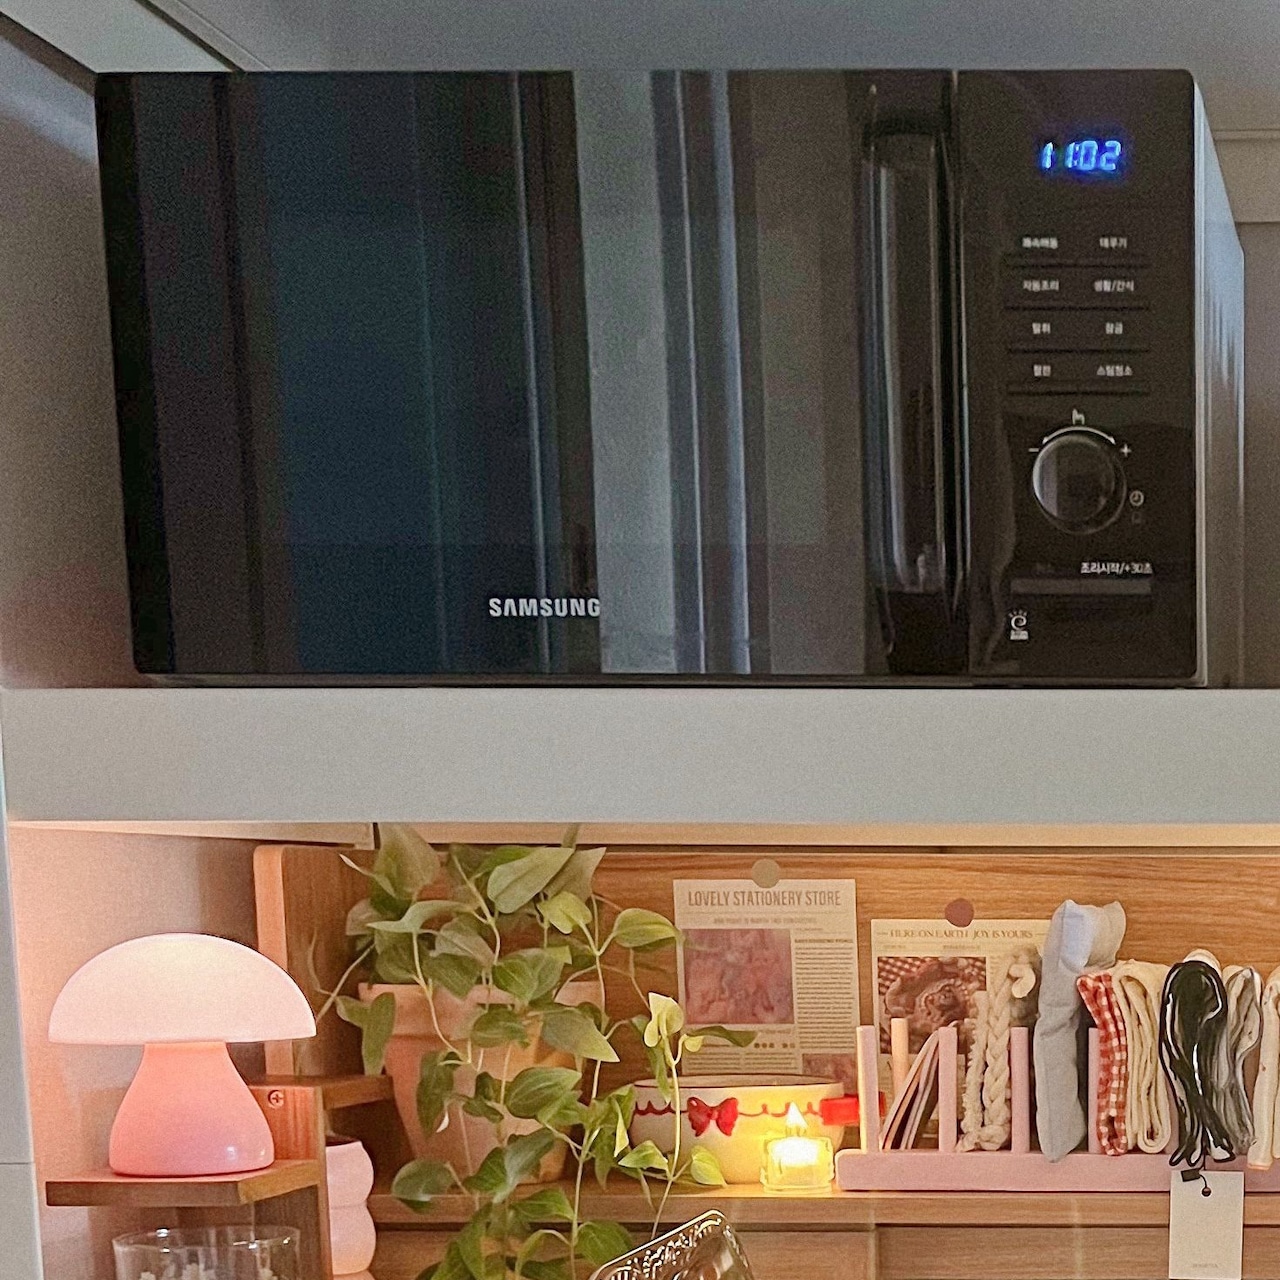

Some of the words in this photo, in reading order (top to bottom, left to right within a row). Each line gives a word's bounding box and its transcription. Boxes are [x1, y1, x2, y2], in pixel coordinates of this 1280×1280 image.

[1041, 140, 1122, 171] 11:02
[489, 598, 600, 617] SAMSUNG
[688, 891, 730, 907] LOVELY
[733, 890, 802, 907] STATIONERY
[805, 890, 842, 906] STORE
[971, 929, 989, 940] JOY
[991, 929, 1001, 938] IS
[1000, 929, 1033, 938] YOURS
